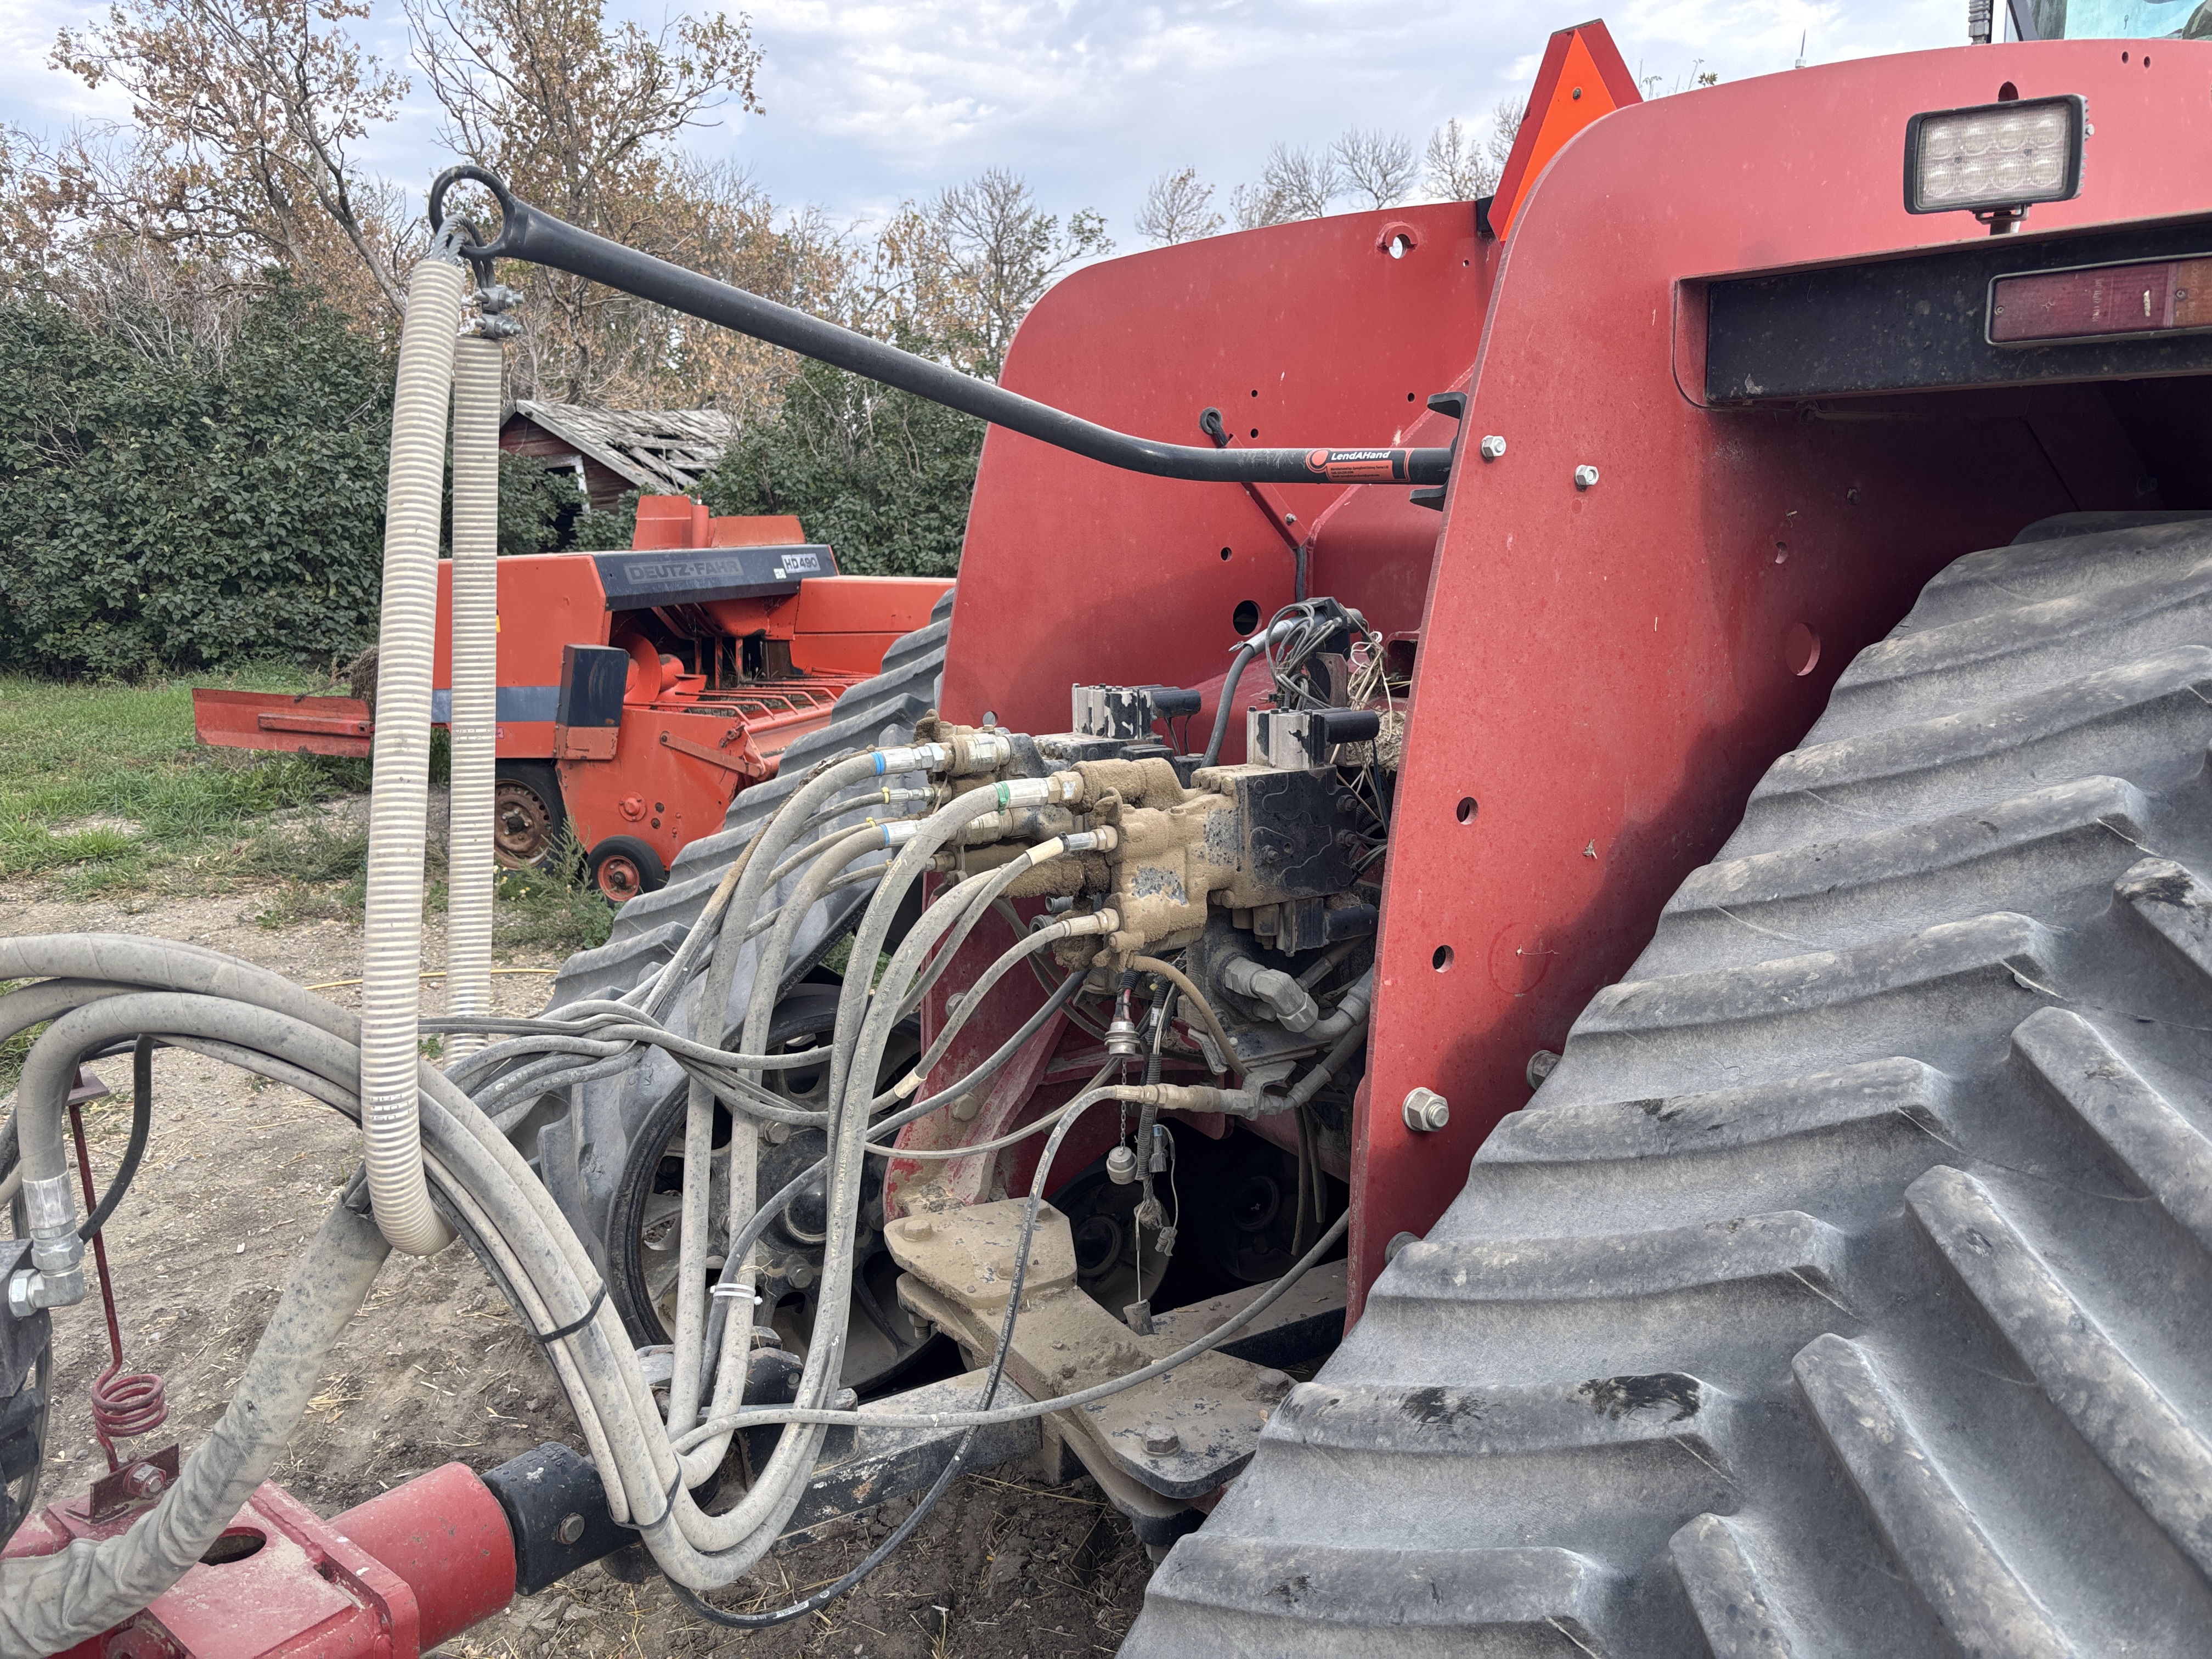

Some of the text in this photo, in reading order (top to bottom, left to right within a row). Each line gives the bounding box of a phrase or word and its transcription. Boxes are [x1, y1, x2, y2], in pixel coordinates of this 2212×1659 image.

[1331, 450, 1391, 460] LendAHand
[630, 561, 740, 580] DEUTZ-FAHR
[838, 1143, 848, 1182] RESISTANT
[1017, 1221, 1029, 1257] WEARGUARD
[985, 1375, 995, 1392] FLAME
